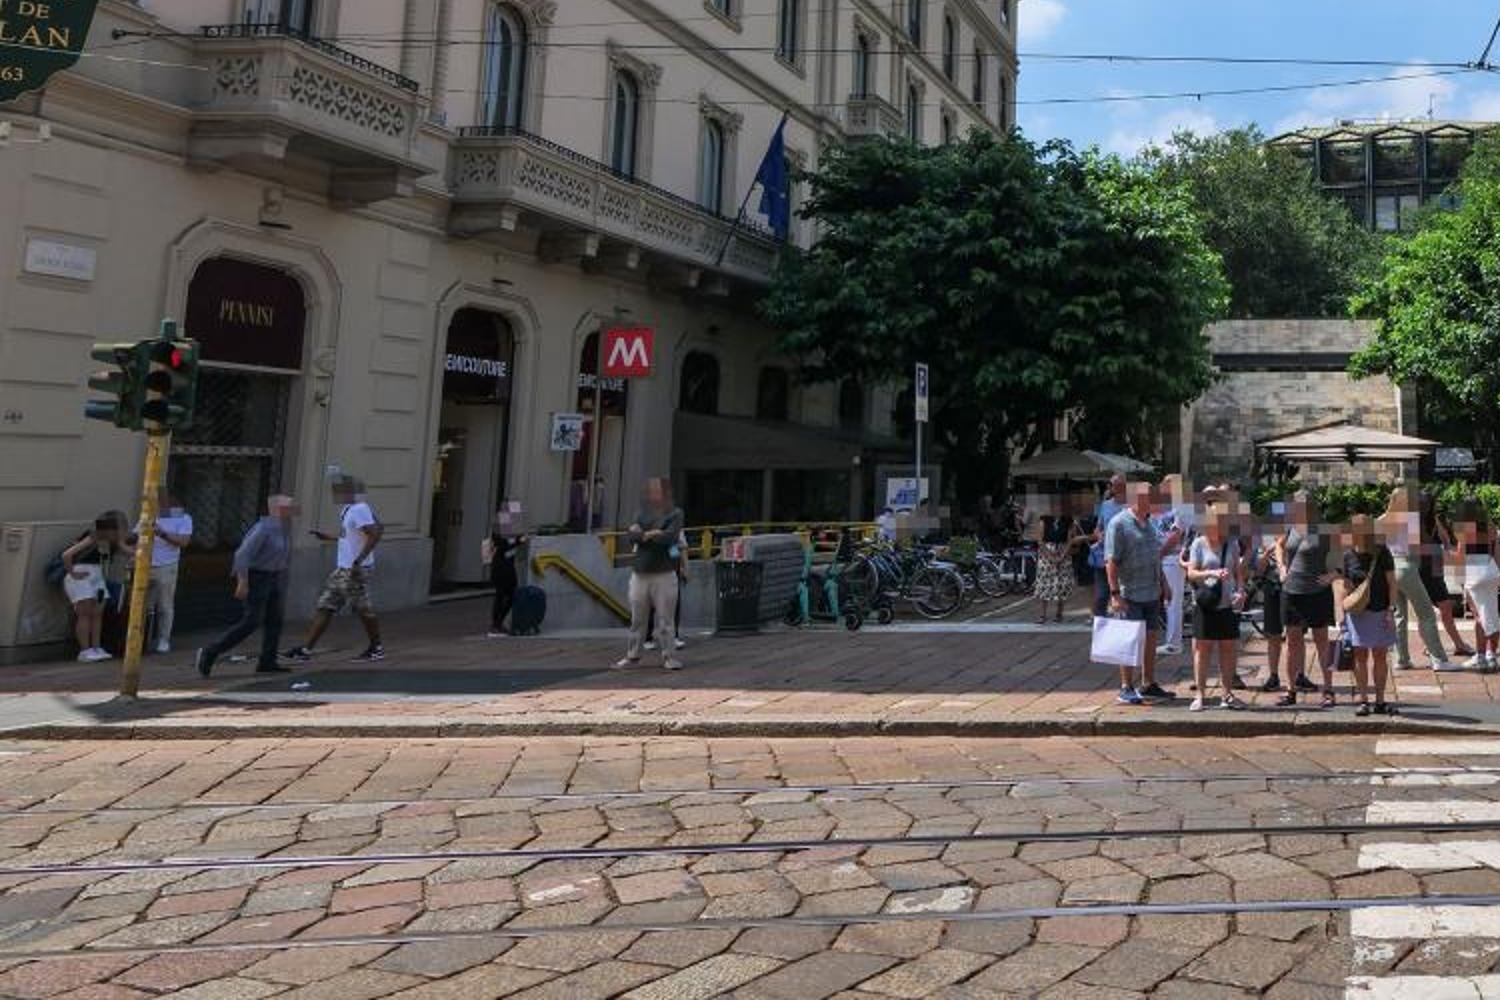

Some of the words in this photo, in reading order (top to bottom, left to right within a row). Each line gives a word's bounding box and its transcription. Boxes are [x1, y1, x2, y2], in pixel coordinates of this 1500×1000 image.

[18, 1, 49, 19] DE
[0, 20, 71, 48] LAN
[608, 337, 648, 367] M
